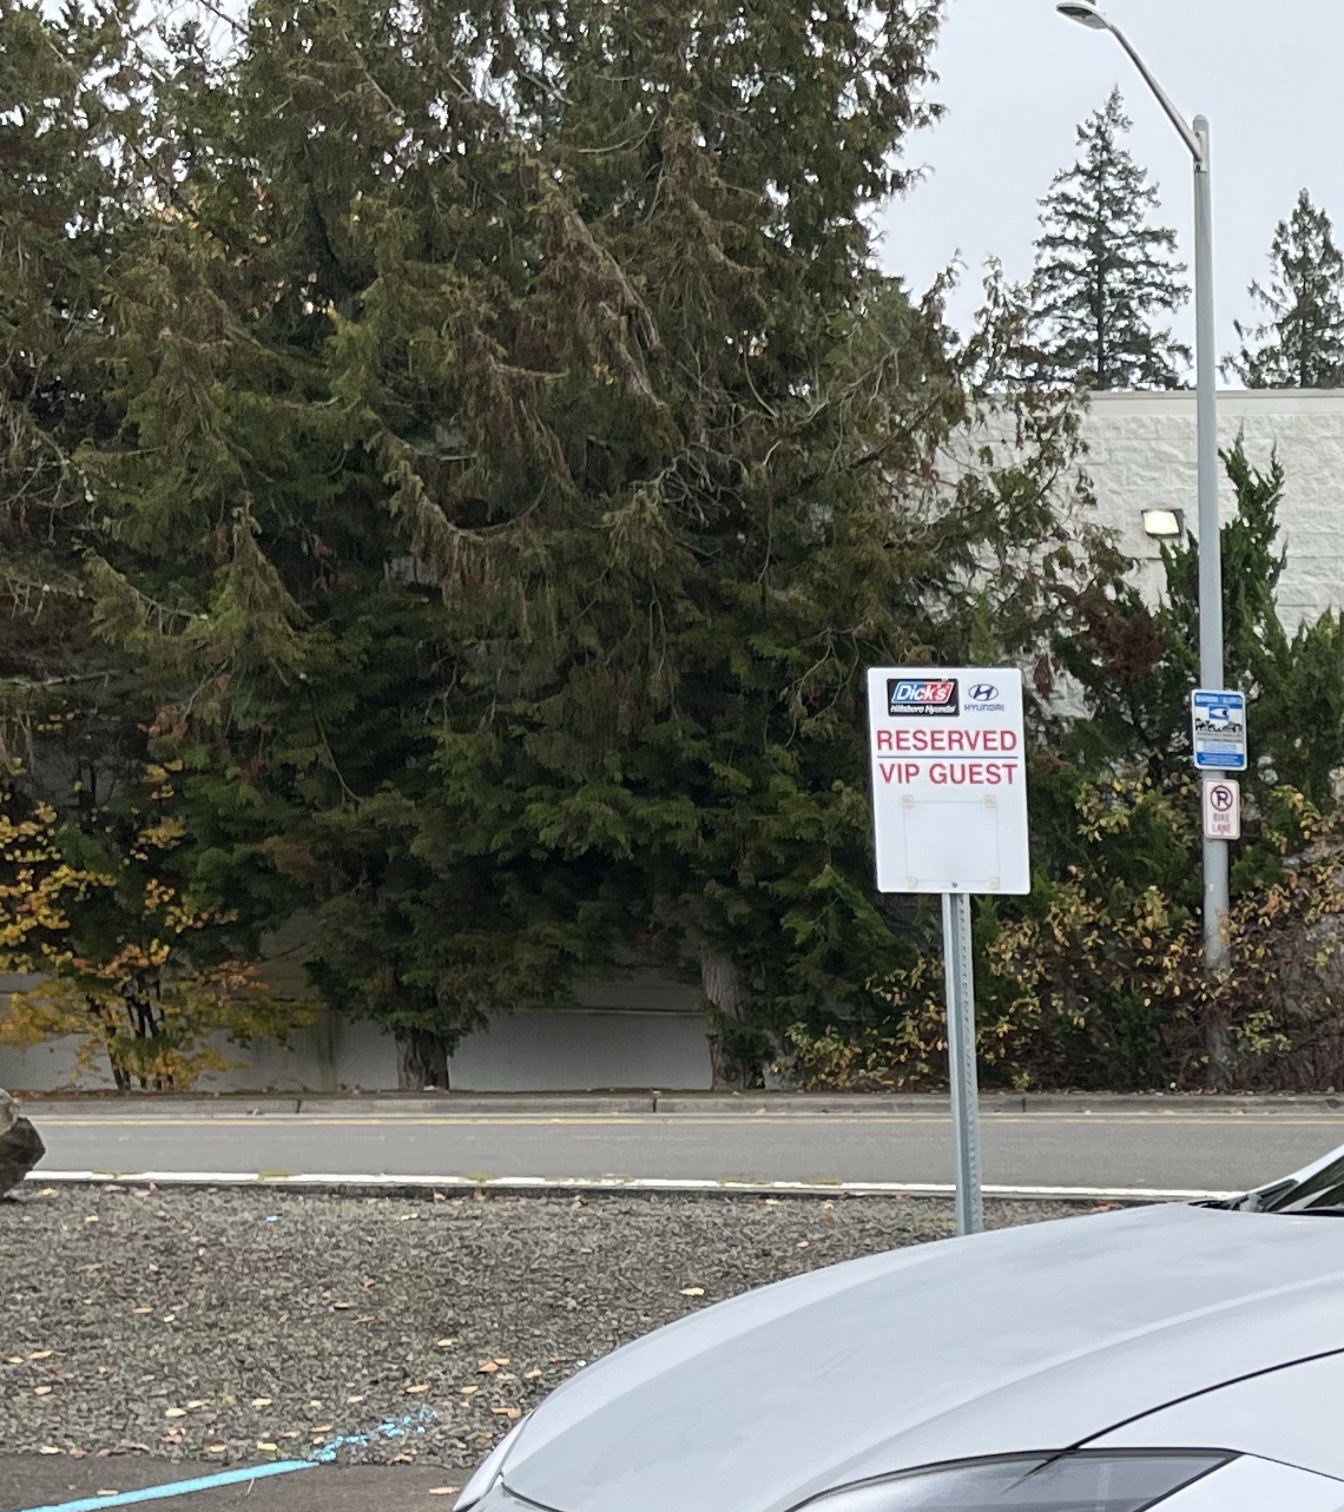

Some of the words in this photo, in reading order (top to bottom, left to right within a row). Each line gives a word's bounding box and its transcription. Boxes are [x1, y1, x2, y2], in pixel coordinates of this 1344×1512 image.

[876, 729, 1018, 752] RESERVED
[879, 763, 920, 785] VIP
[929, 763, 1018, 786] GUEST
